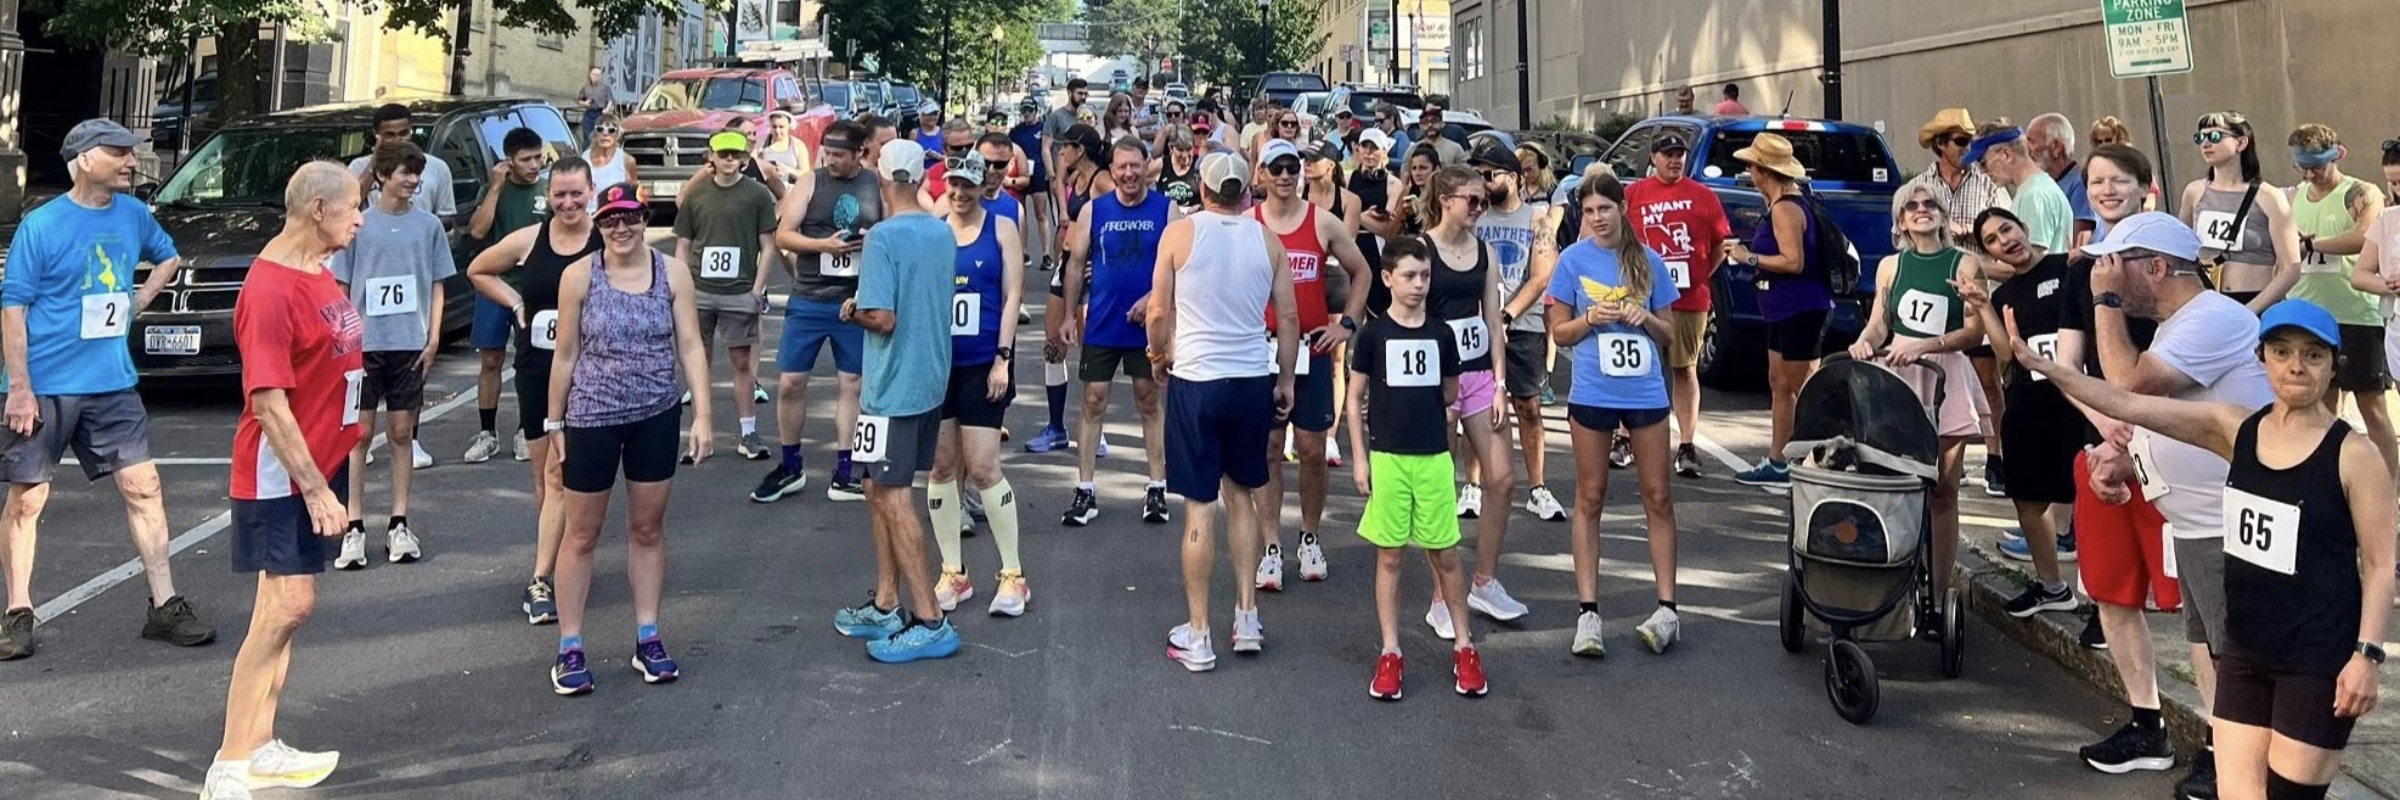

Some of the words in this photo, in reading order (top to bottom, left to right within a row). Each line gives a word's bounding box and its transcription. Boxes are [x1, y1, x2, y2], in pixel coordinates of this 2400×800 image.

[2126, 6, 2163, 21] ZONE
[2118, 24, 2142, 35] MON
[2157, 21, 2174, 32] FRI
[2118, 37, 2141, 48] 9AM
[2155, 33, 2178, 44] 5PM
[1641, 206, 1646, 215] I
[1649, 200, 1692, 214] WANT
[1104, 221, 1154, 231] FIRECRACKER
[1643, 213, 1664, 225] MY
[2207, 219, 2232, 241] 42
[710, 251, 732, 272] 38
[380, 284, 403, 306] 76
[105, 302, 116, 327] 2
[951, 300, 969, 327] 0
[1909, 299, 1934, 323] 17
[1461, 326, 1480, 351] 45
[1403, 350, 1427, 375] 18
[1611, 339, 1641, 369] 35
[2037, 341, 2058, 362] 5
[853, 422, 876, 454] 59
[2239, 507, 2274, 552] 65
